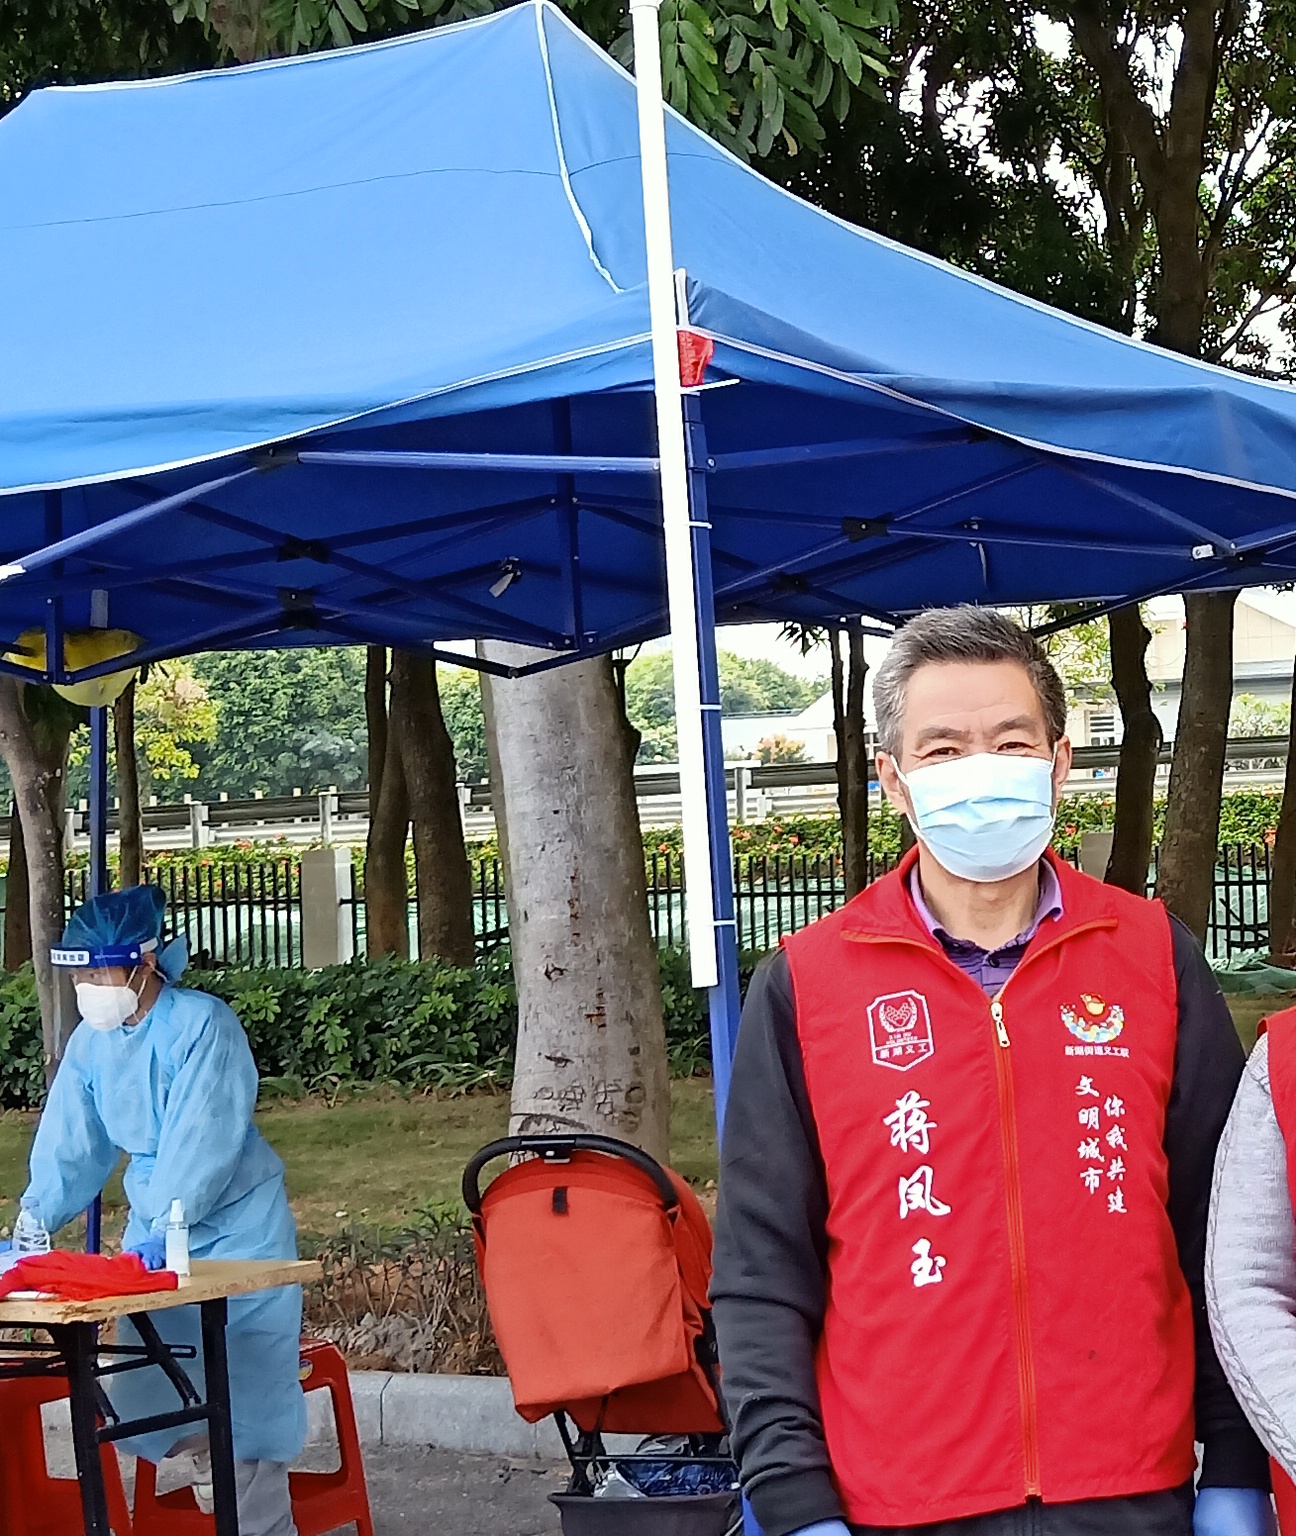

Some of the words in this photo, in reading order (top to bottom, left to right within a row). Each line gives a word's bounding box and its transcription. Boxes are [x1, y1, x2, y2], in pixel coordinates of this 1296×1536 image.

[884, 1090, 951, 1288] 蒋凤玉
[1075, 1075, 1104, 1195] 文明城市
[1104, 1094, 1128, 1214] 你我共建
